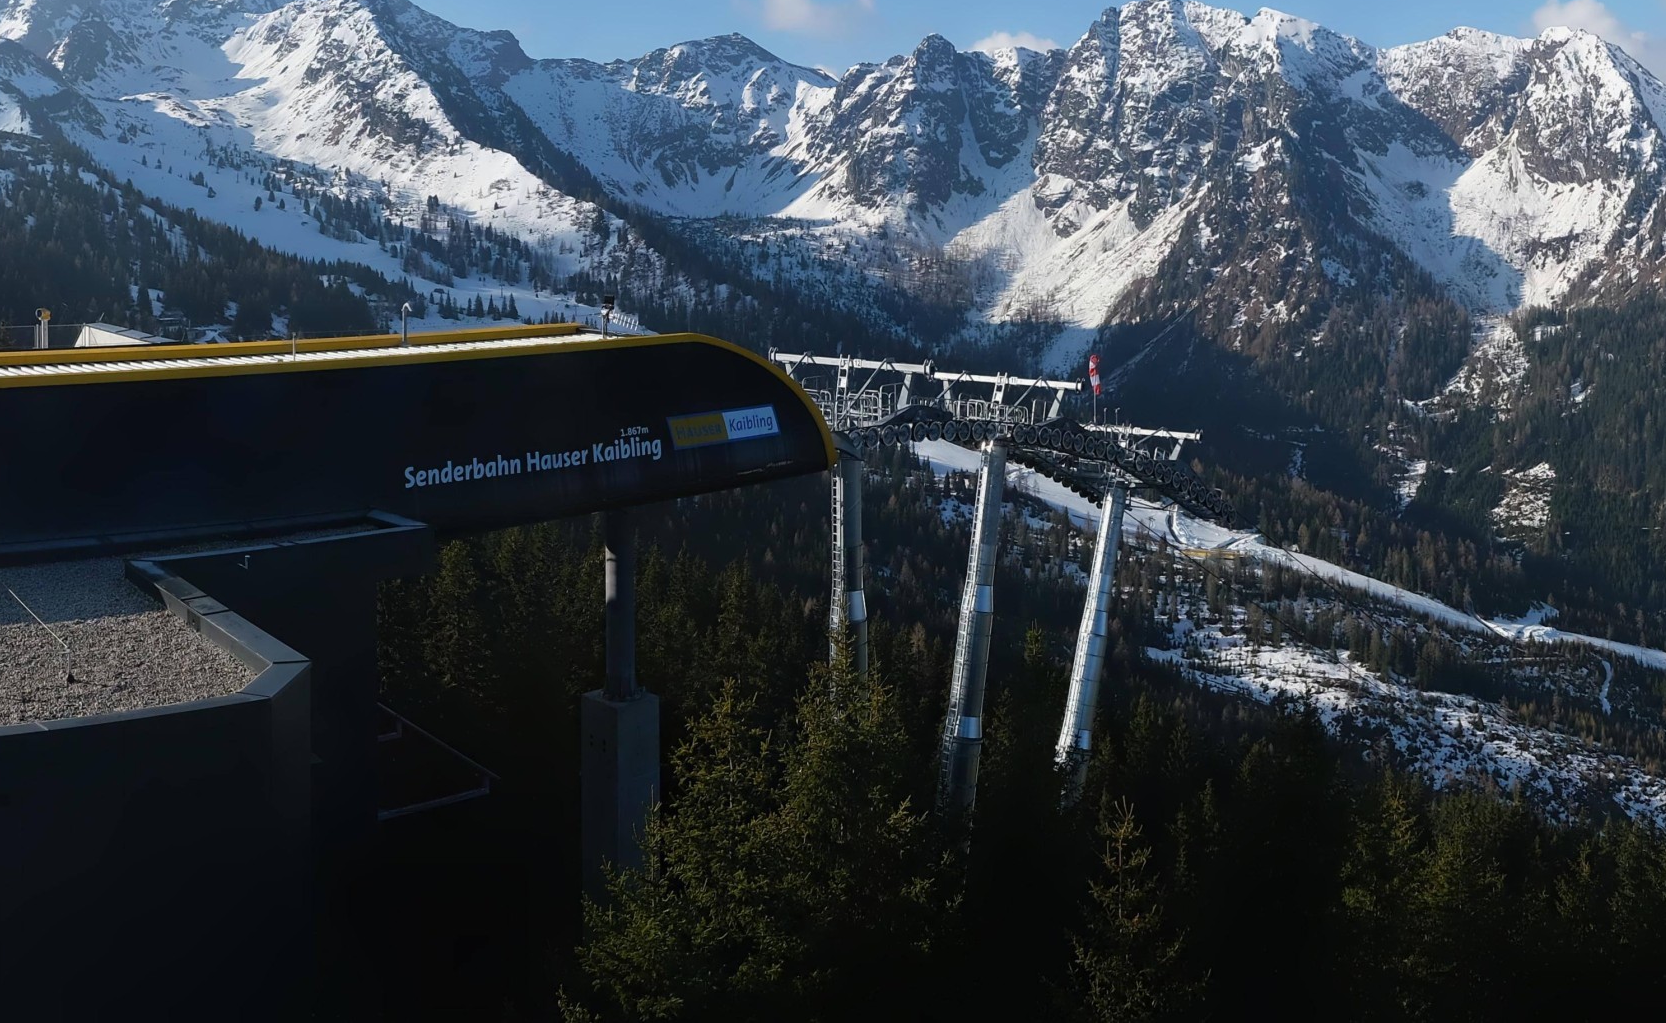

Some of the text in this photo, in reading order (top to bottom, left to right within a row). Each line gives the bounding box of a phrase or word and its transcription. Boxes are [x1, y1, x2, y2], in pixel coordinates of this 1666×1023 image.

[620, 426, 649, 437] 1.867m
[675, 412, 774, 440] HAUSER Kaibling
[404, 434, 662, 489] Senderbahn Hauser Kaibling
